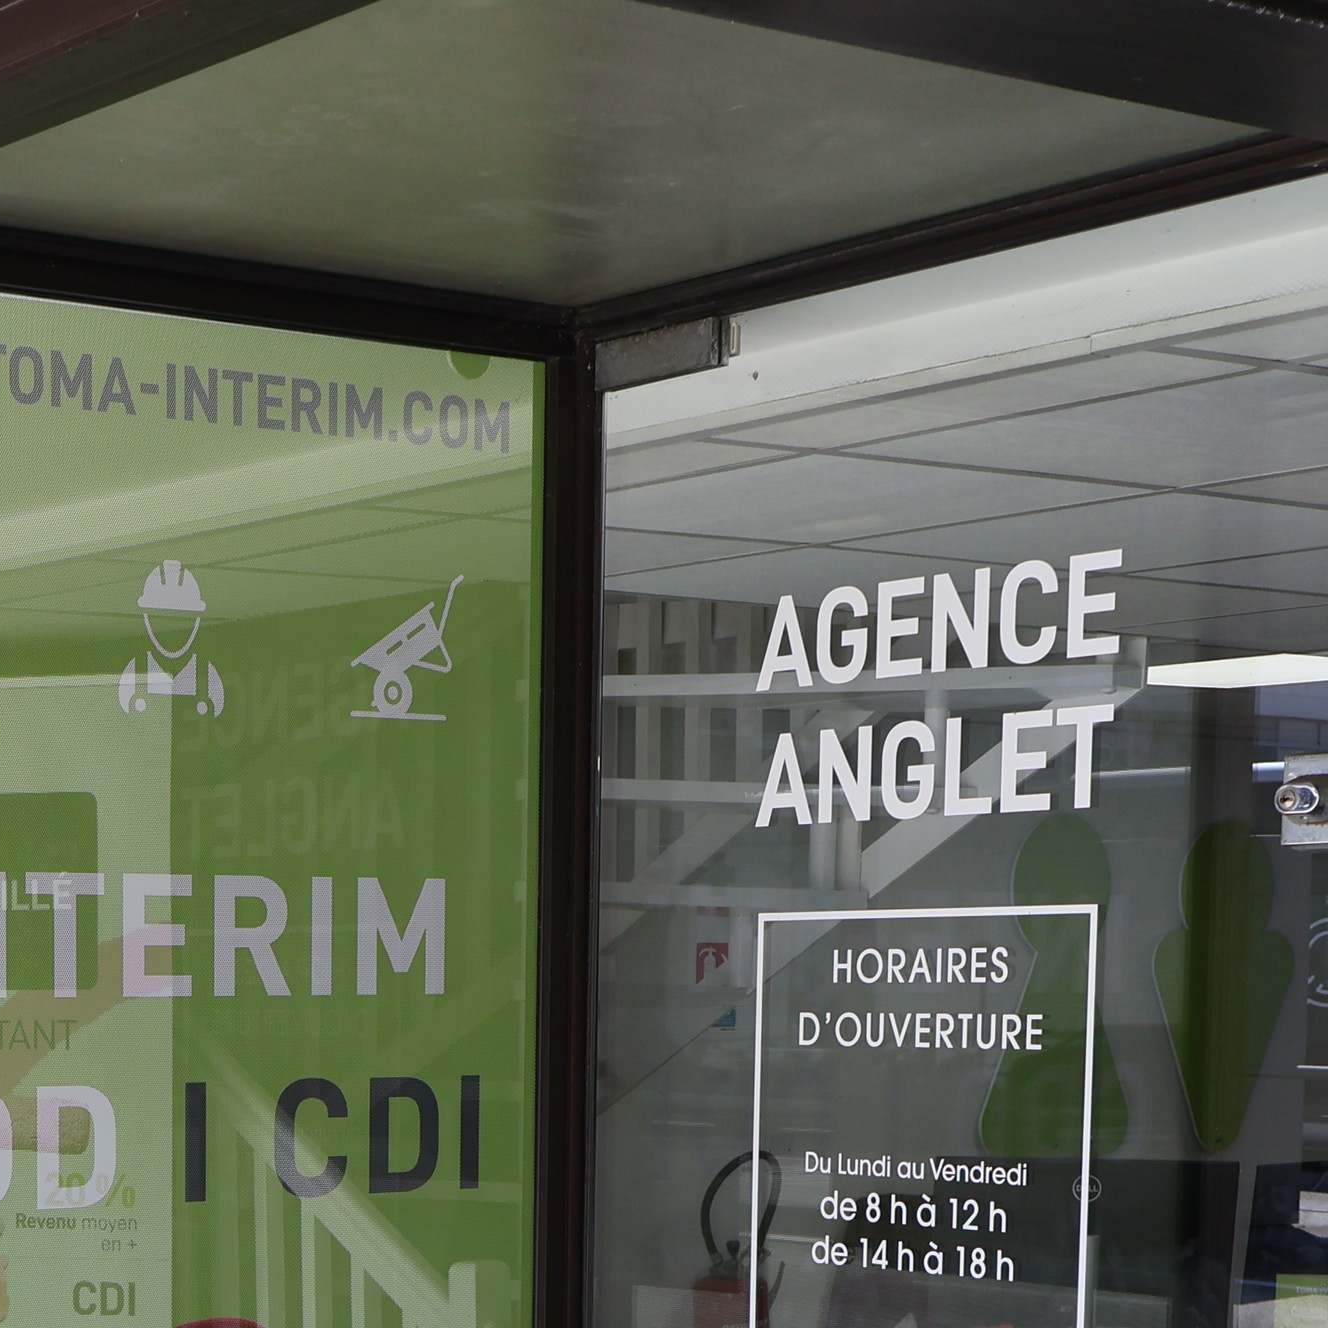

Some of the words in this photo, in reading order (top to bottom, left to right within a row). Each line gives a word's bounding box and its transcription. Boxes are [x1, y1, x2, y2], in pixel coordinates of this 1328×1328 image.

[755, 548, 1123, 692] AGENCE
[755, 703, 1114, 828] ANGLET
[832, 946, 1009, 984] HORAIRES
[798, 1011, 1044, 1051] D'OUVERTURE
[273, 1075, 481, 1200] CDI
[804, 1151, 831, 1175] Du
[837, 1152, 891, 1179] Lundi
[897, 1161, 925, 1180] au
[930, 1157, 1028, 1187] Vendredi
[15, 1213, 76, 1231] Revenu
[81, 1215, 138, 1238] moyen
[820, 1190, 857, 1222] de
[866, 1191, 881, 1224] 8
[890, 1193, 907, 1225] h
[916, 1193, 936, 1229] à
[949, 1197, 979, 1232] 12
[989, 1201, 1008, 1234] h
[101, 1236, 122, 1252] en
[811, 1235, 848, 1266] de
[860, 1237, 889, 1270] 14
[897, 1241, 914, 1273] h
[923, 1241, 943, 1276] à
[956, 1246, 986, 1280] 18
[996, 1249, 1015, 1282] h
[72, 1281, 136, 1317] CDI
